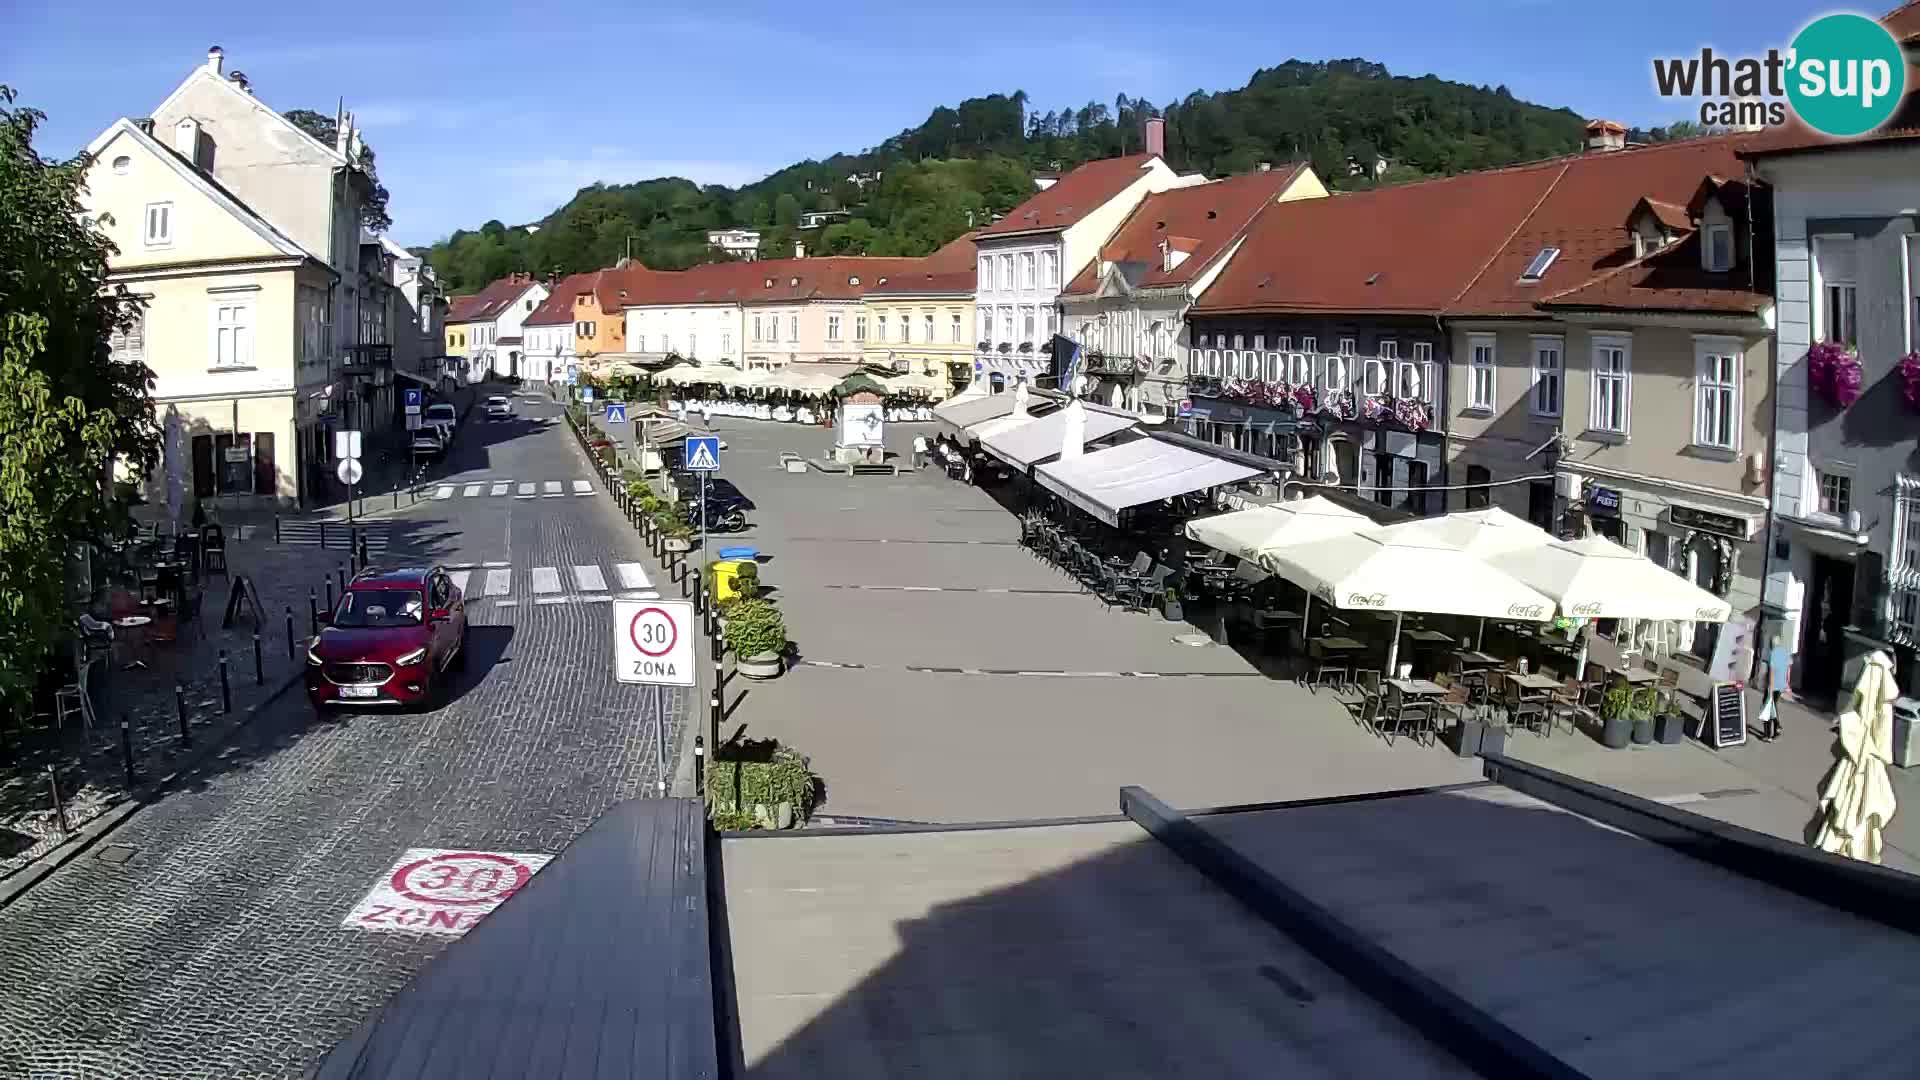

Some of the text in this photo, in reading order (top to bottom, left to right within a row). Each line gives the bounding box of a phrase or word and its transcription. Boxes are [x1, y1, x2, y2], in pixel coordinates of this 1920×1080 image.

[643, 623, 666, 643] 30
[633, 660, 676, 677] ZONA
[419, 865, 504, 892] 30
